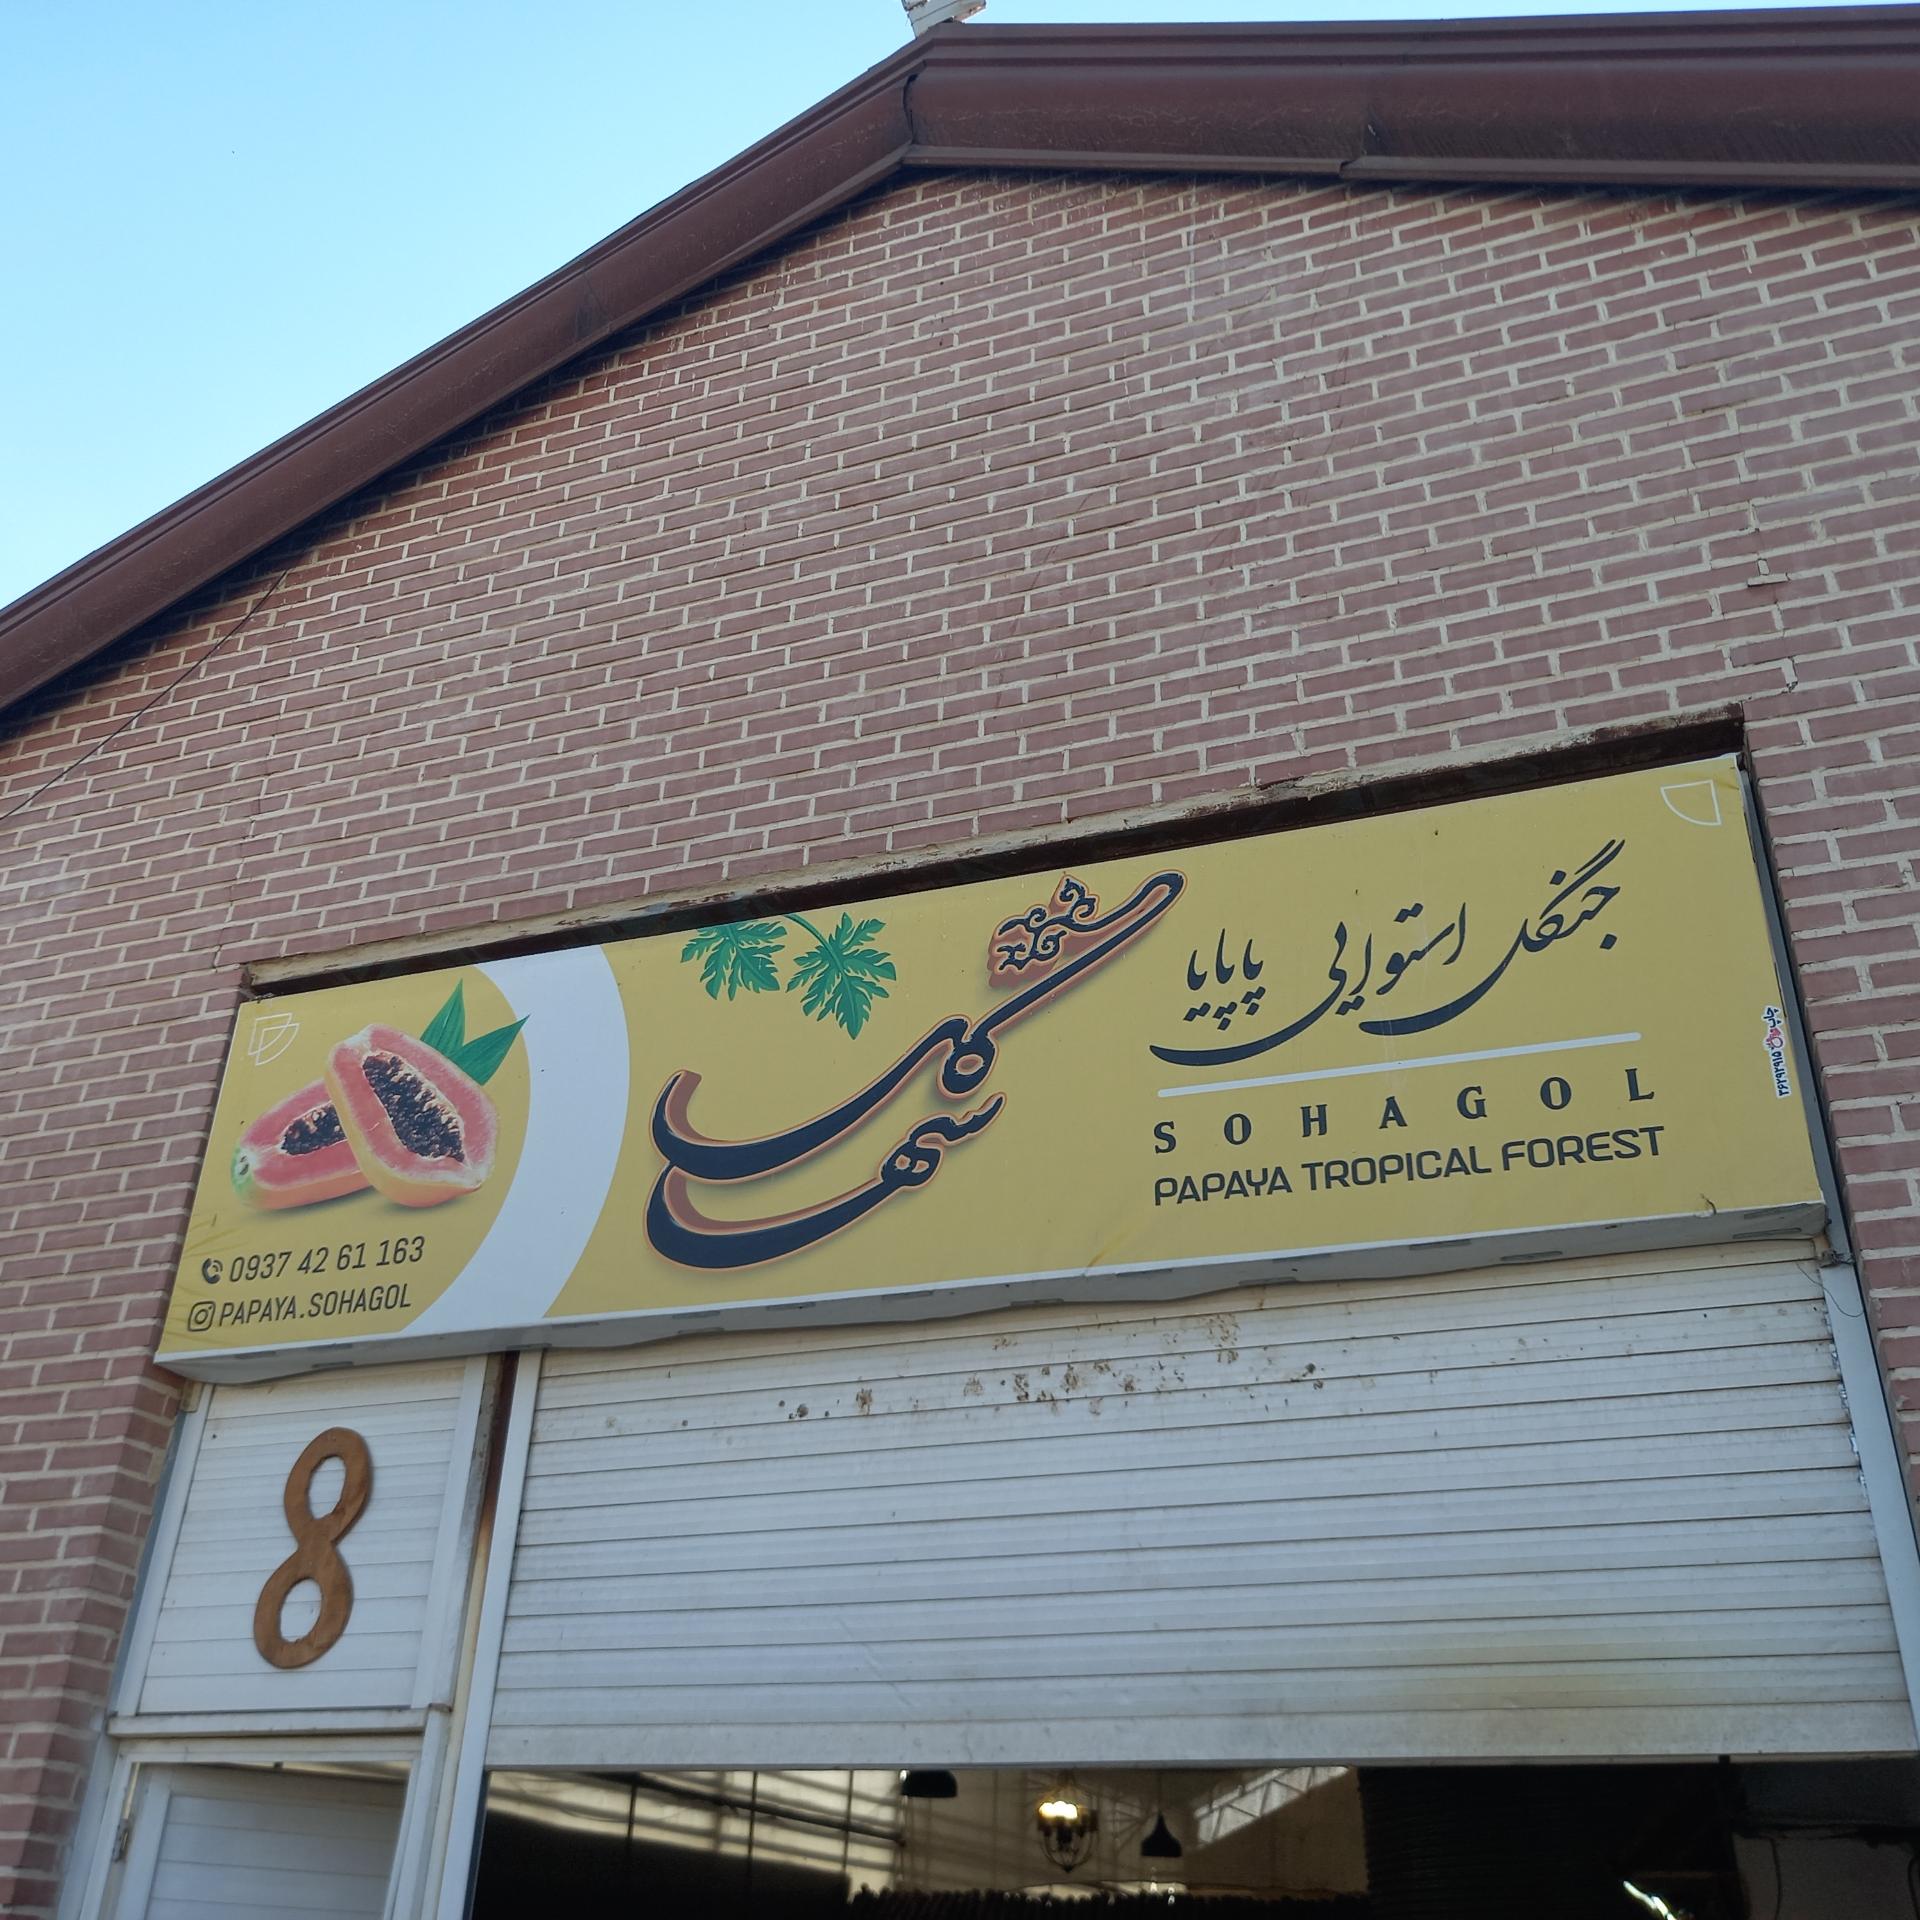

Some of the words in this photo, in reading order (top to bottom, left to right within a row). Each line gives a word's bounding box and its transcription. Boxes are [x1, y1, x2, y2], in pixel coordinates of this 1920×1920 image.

[1358, 838, 1627, 1037] جنگل
[1182, 928, 1266, 1032] پاپایا
[1763, 1006, 1781, 1029] چاپ
[1153, 1067, 1655, 1154] SOHAGOL
[1154, 1166, 1293, 1207] PAPAYA
[1300, 1145, 1493, 1191] TROPICAL
[1501, 1125, 1665, 1172] FOREST
[229, 1251, 293, 1283] 0937
[296, 1246, 329, 1275] 42
[336, 1242, 367, 1271] 61
[375, 1235, 426, 1267] 163
[218, 1282, 413, 1328] PAPAYA.SOHAGOL
[252, 1426, 373, 1669] 8
